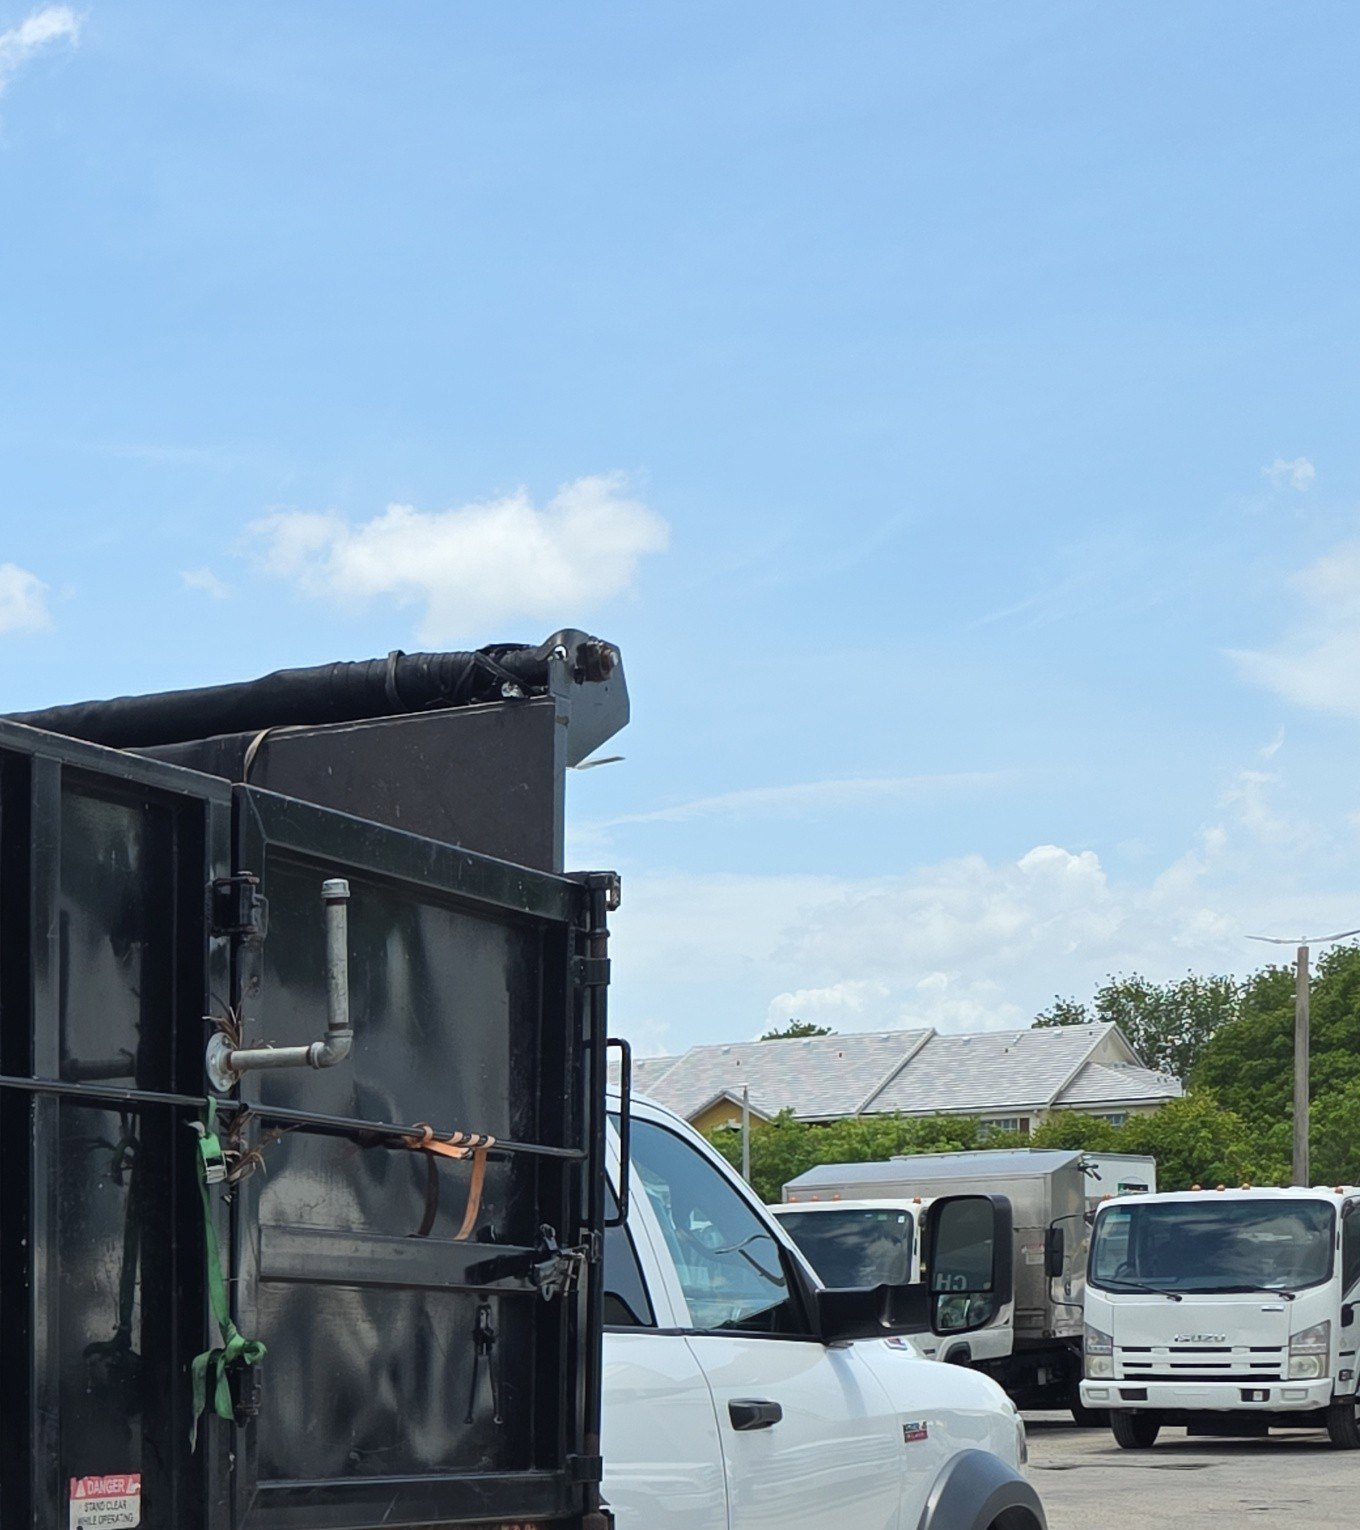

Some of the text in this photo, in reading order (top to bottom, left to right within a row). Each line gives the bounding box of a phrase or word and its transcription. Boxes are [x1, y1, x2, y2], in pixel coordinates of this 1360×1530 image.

[1174, 1333, 1227, 1342] ISUZU
[87, 1479, 126, 1495] DANGER
[84, 1499, 127, 1513] STAND CLEAR
[99, 1513, 134, 1525] OPERATING
